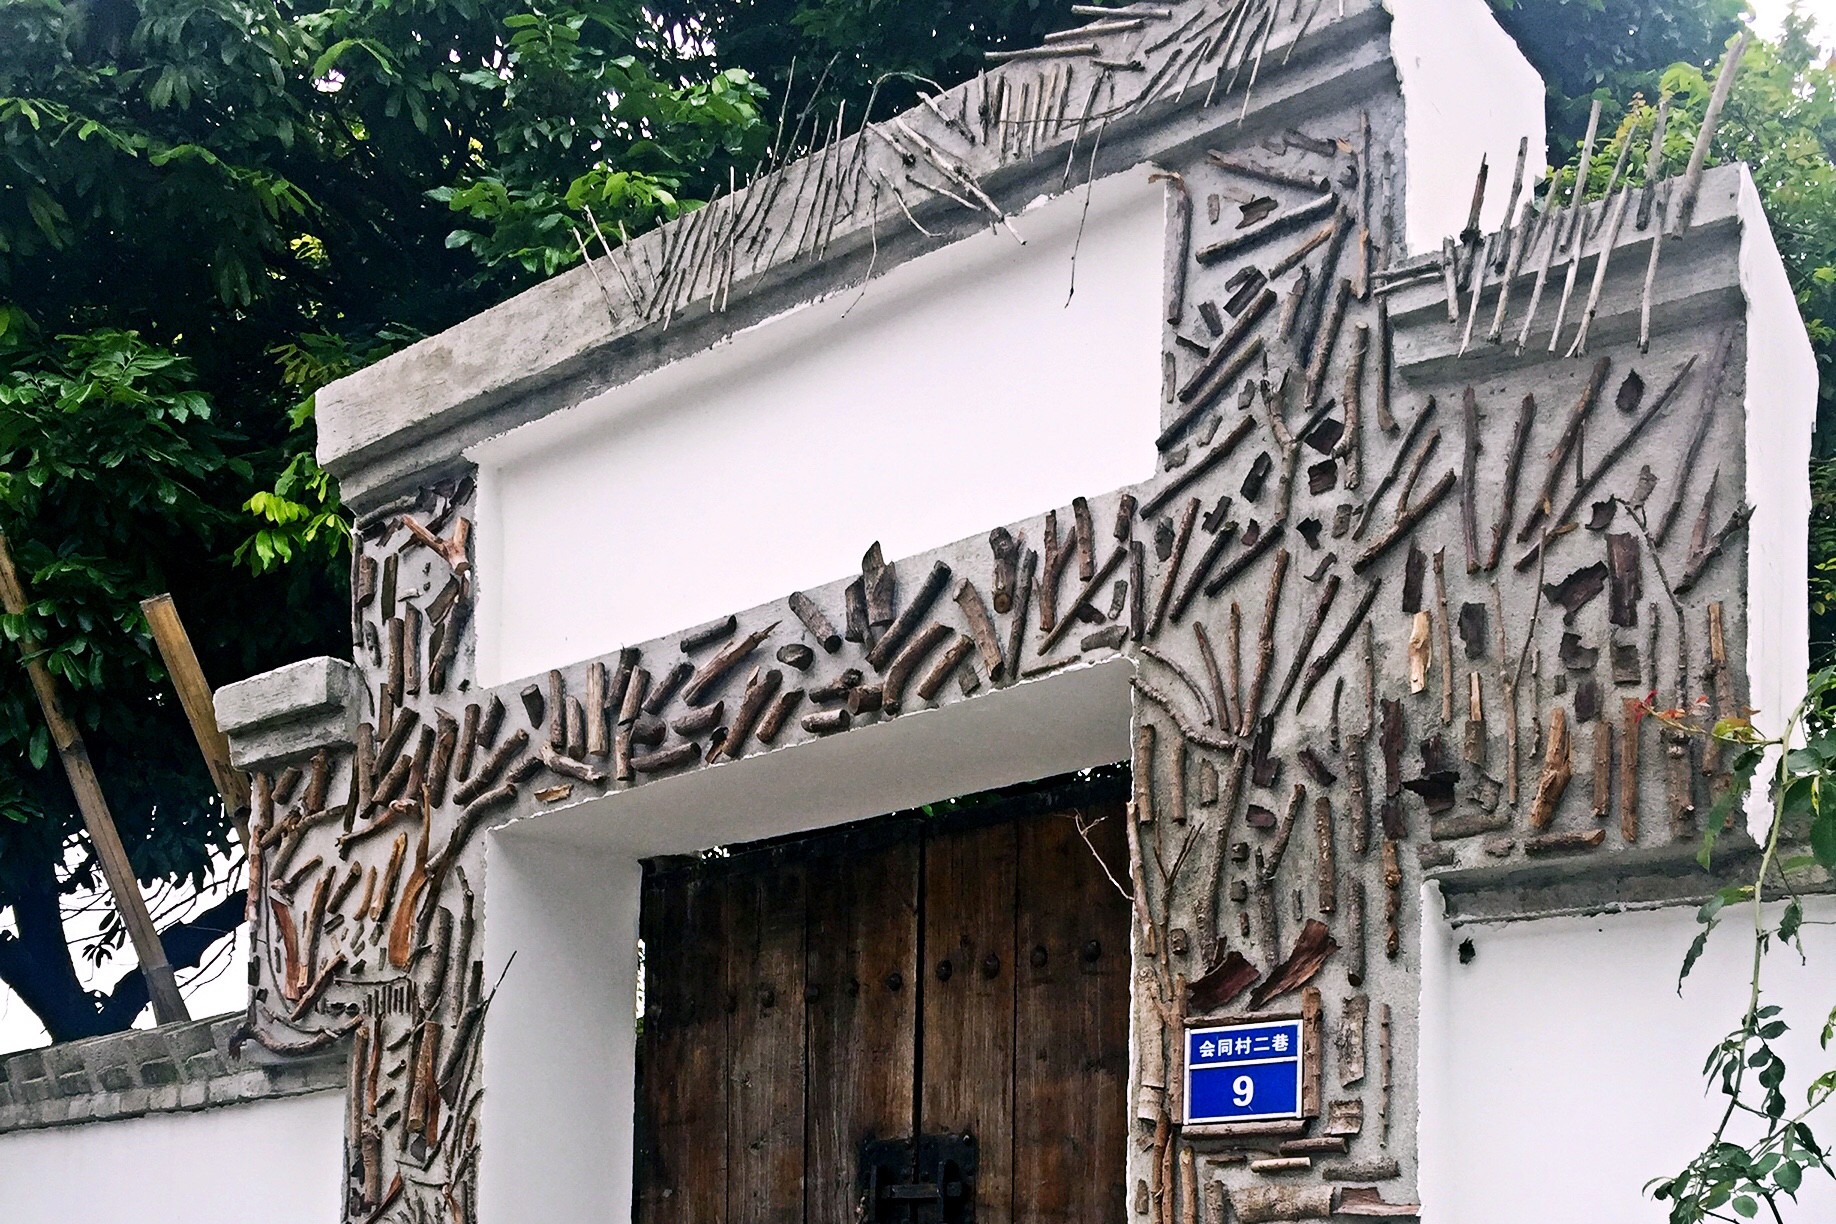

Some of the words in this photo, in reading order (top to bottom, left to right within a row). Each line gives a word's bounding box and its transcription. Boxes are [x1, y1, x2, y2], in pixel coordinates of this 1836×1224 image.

[1199, 1033, 1289, 1057] 会同村二巷
[1232, 1075, 1254, 1107] 9
